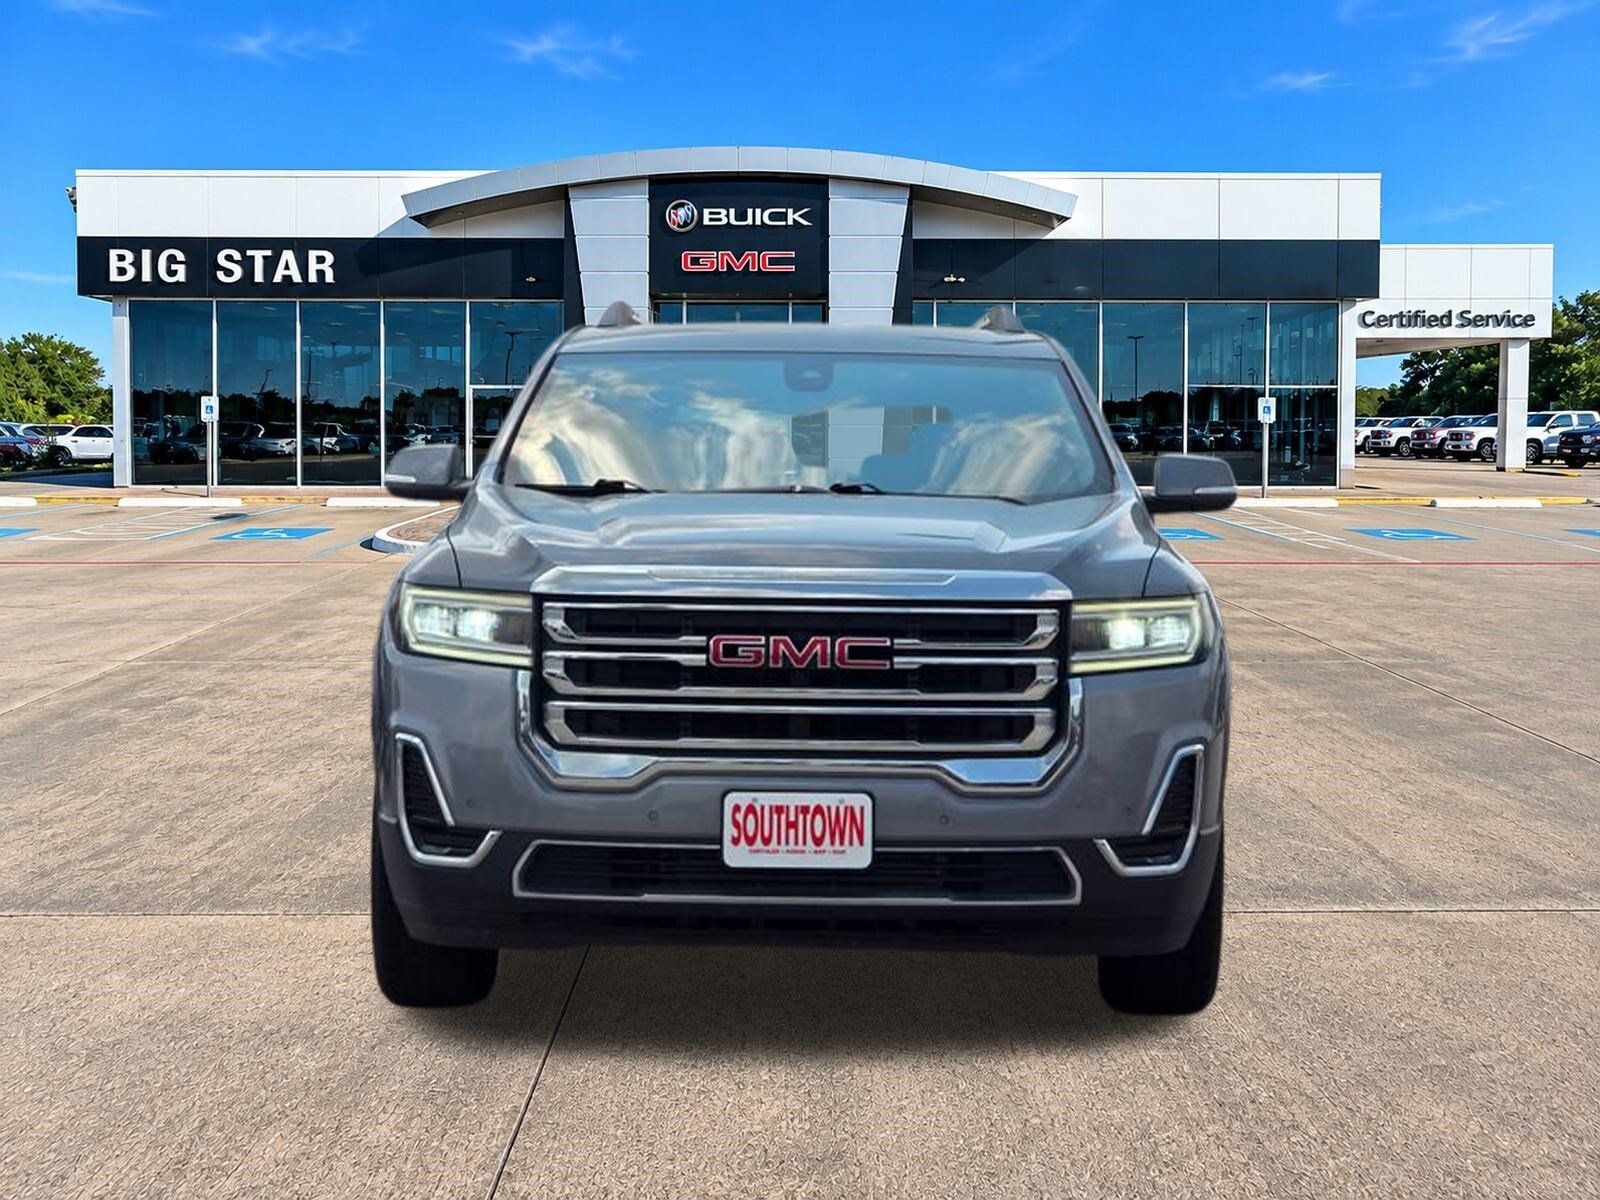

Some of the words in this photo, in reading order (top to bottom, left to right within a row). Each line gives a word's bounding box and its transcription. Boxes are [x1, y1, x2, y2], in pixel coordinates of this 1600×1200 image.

[702, 207, 813, 226] BUICK
[108, 248, 187, 283] BIG
[215, 248, 336, 284] STAR
[681, 251, 795, 272] GMC
[1360, 310, 1453, 328] Certified
[1456, 310, 1536, 328] Service
[709, 635, 891, 669] GMC
[731, 803, 864, 848] SOUTHTOWN
